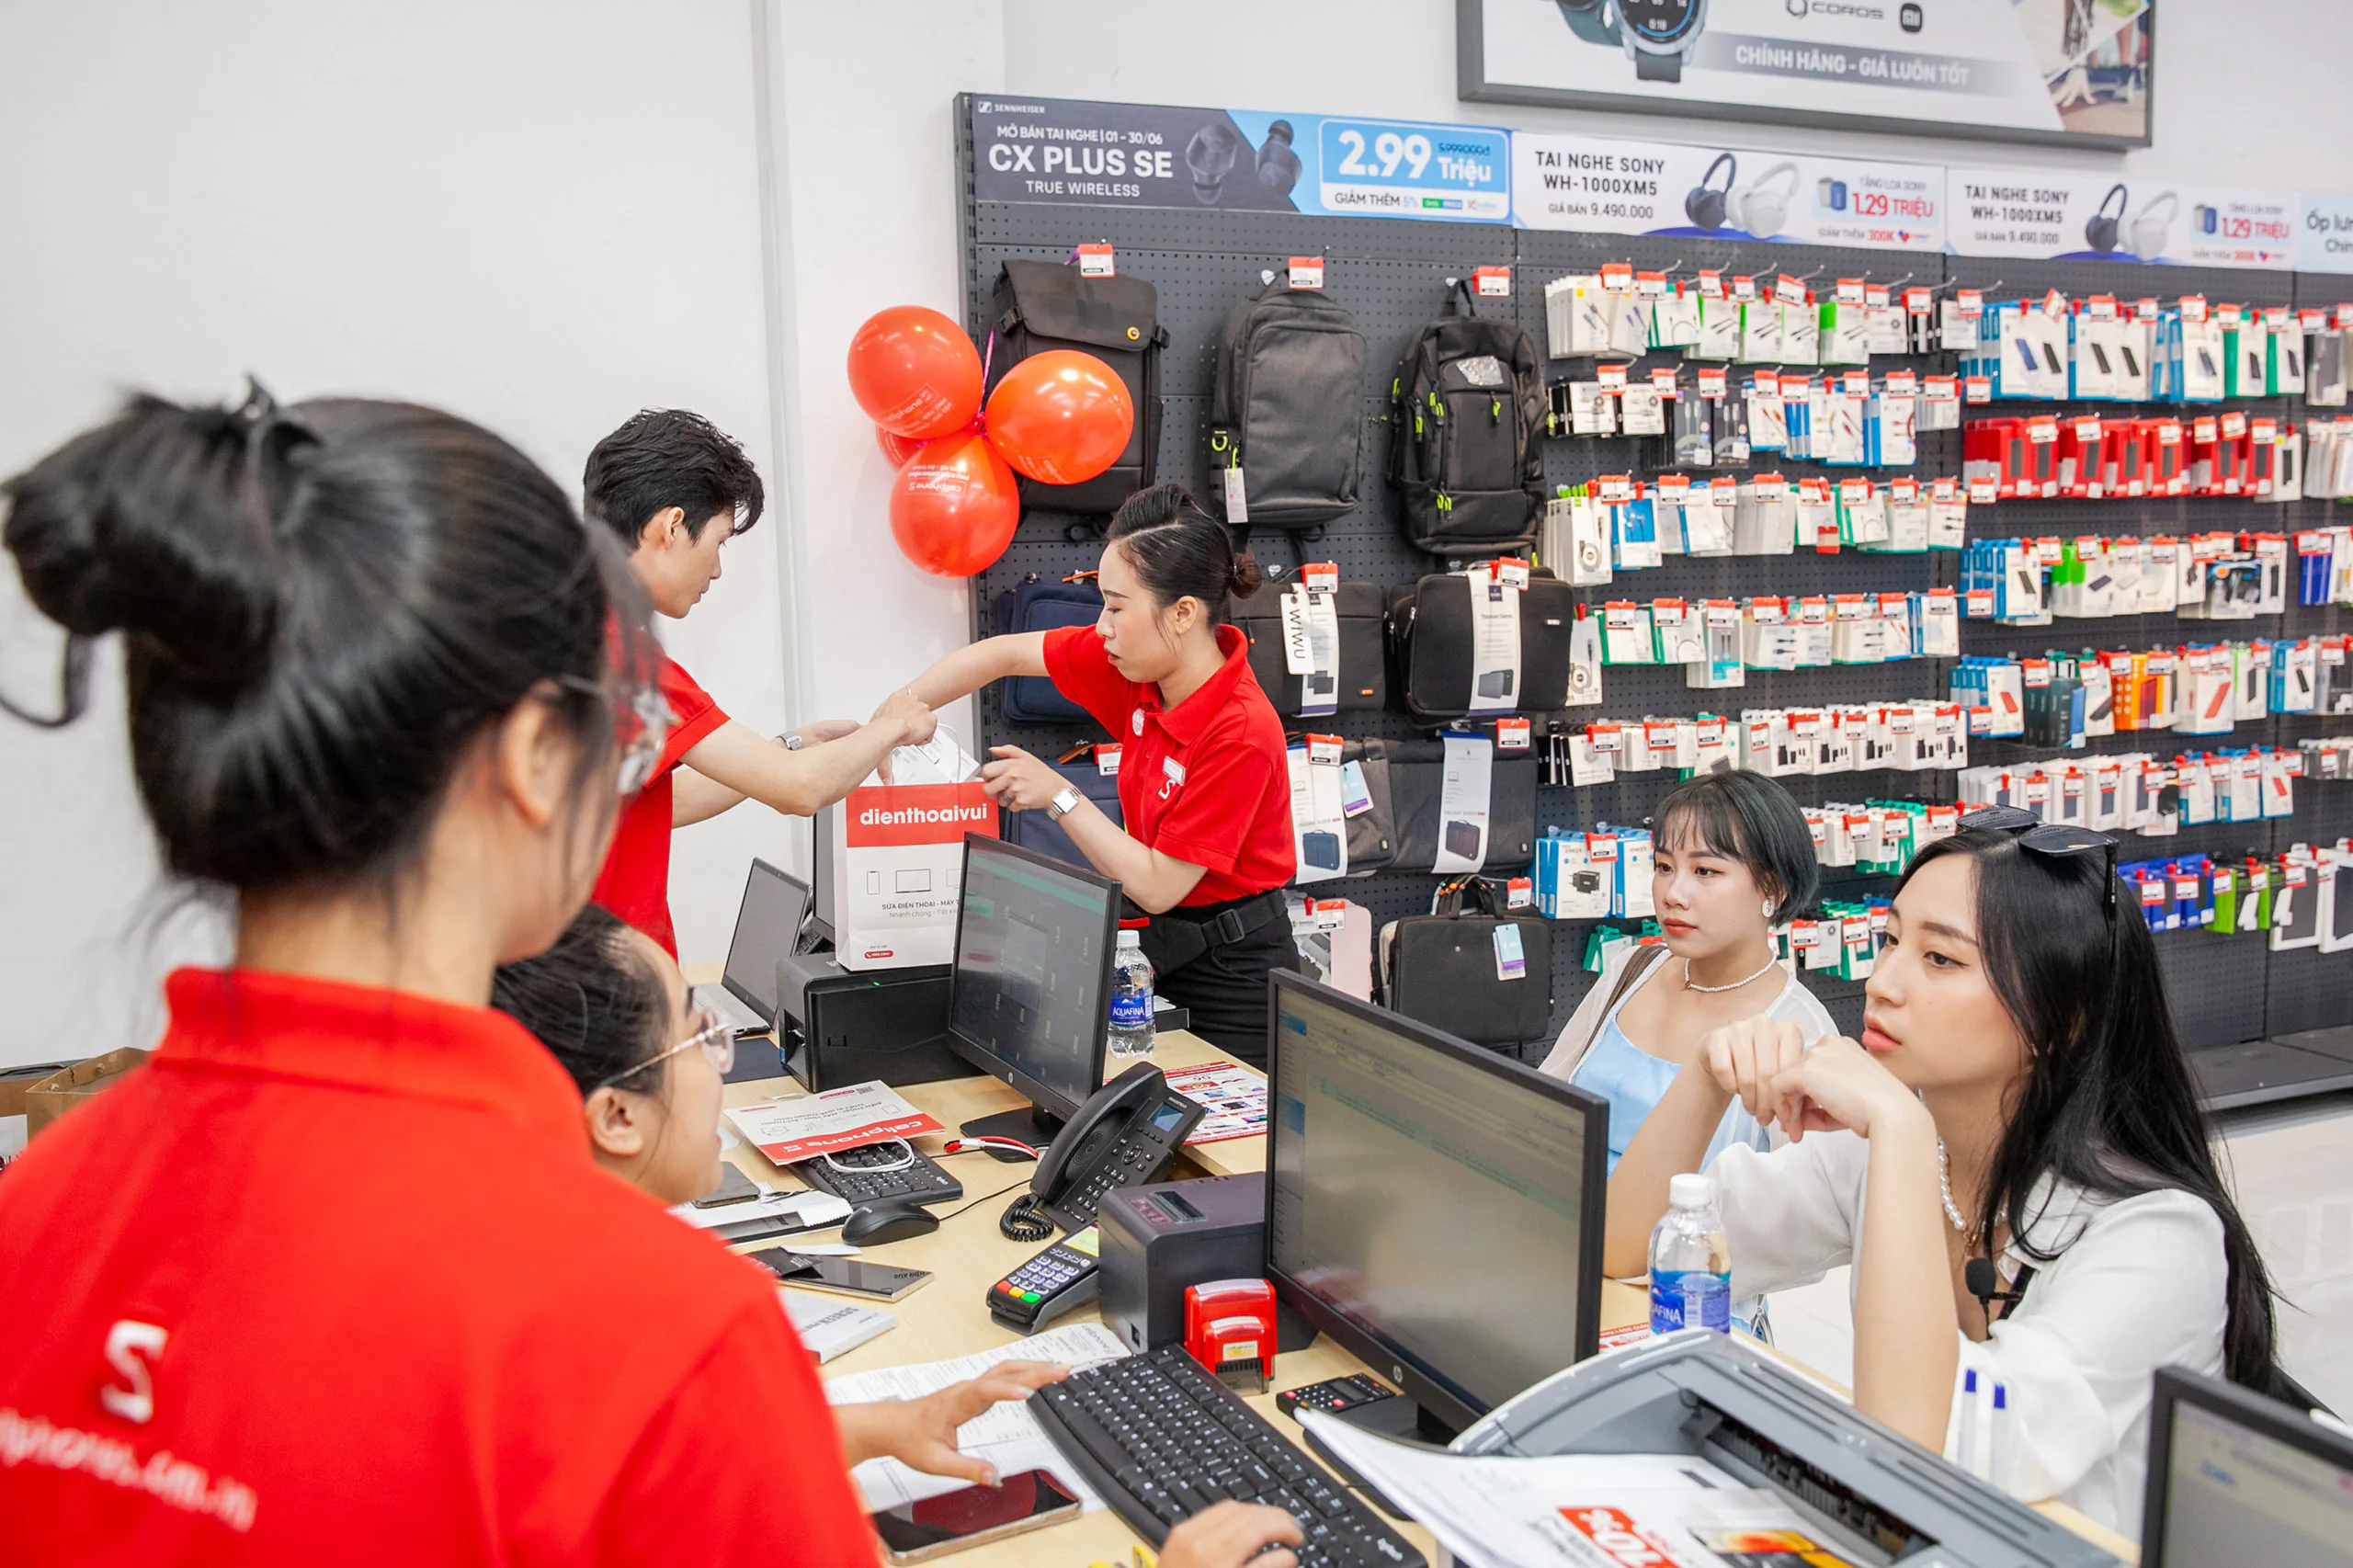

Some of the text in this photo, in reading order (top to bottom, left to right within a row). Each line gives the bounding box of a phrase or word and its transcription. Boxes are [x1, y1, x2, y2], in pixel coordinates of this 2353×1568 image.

[1735, 43, 1793, 69] CHÍNH
[1859, 56, 1890, 78] GIÁ
[1891, 60, 1936, 83] LUÔN
[995, 103, 1046, 114] SENNHEISER
[996, 122, 1018, 139] MỞ
[1019, 124, 1045, 140] BÁN
[1046, 127, 1064, 140] TAI
[1065, 129, 1098, 142] NGHE
[1128, 131, 1164, 145] 30/06
[988, 142, 1174, 178] CX PLUS SE
[1337, 130, 1433, 179] 2.99
[1535, 151, 1665, 175] TAI NGHE SONY
[1437, 156, 1492, 187] Triệu
[1026, 180, 1141, 198] TRUE WIRELESS
[1543, 174, 1658, 196] WH-1000XM5
[1965, 185, 2070, 204] TAI NGHE SONY
[1335, 188, 1367, 204] GIẢM
[1370, 191, 1401, 207] THÊM
[1892, 196, 1934, 221] TRIỆU
[1590, 202, 1654, 219] 9.490.000
[1971, 206, 2063, 224] WH-1000XM5
[2306, 206, 2331, 234] Ốp
[1289, 608, 1306, 659] WIWU
[859, 803, 987, 825] dienthoaivui
[1112, 1006, 1146, 1017] AQUAFINA
